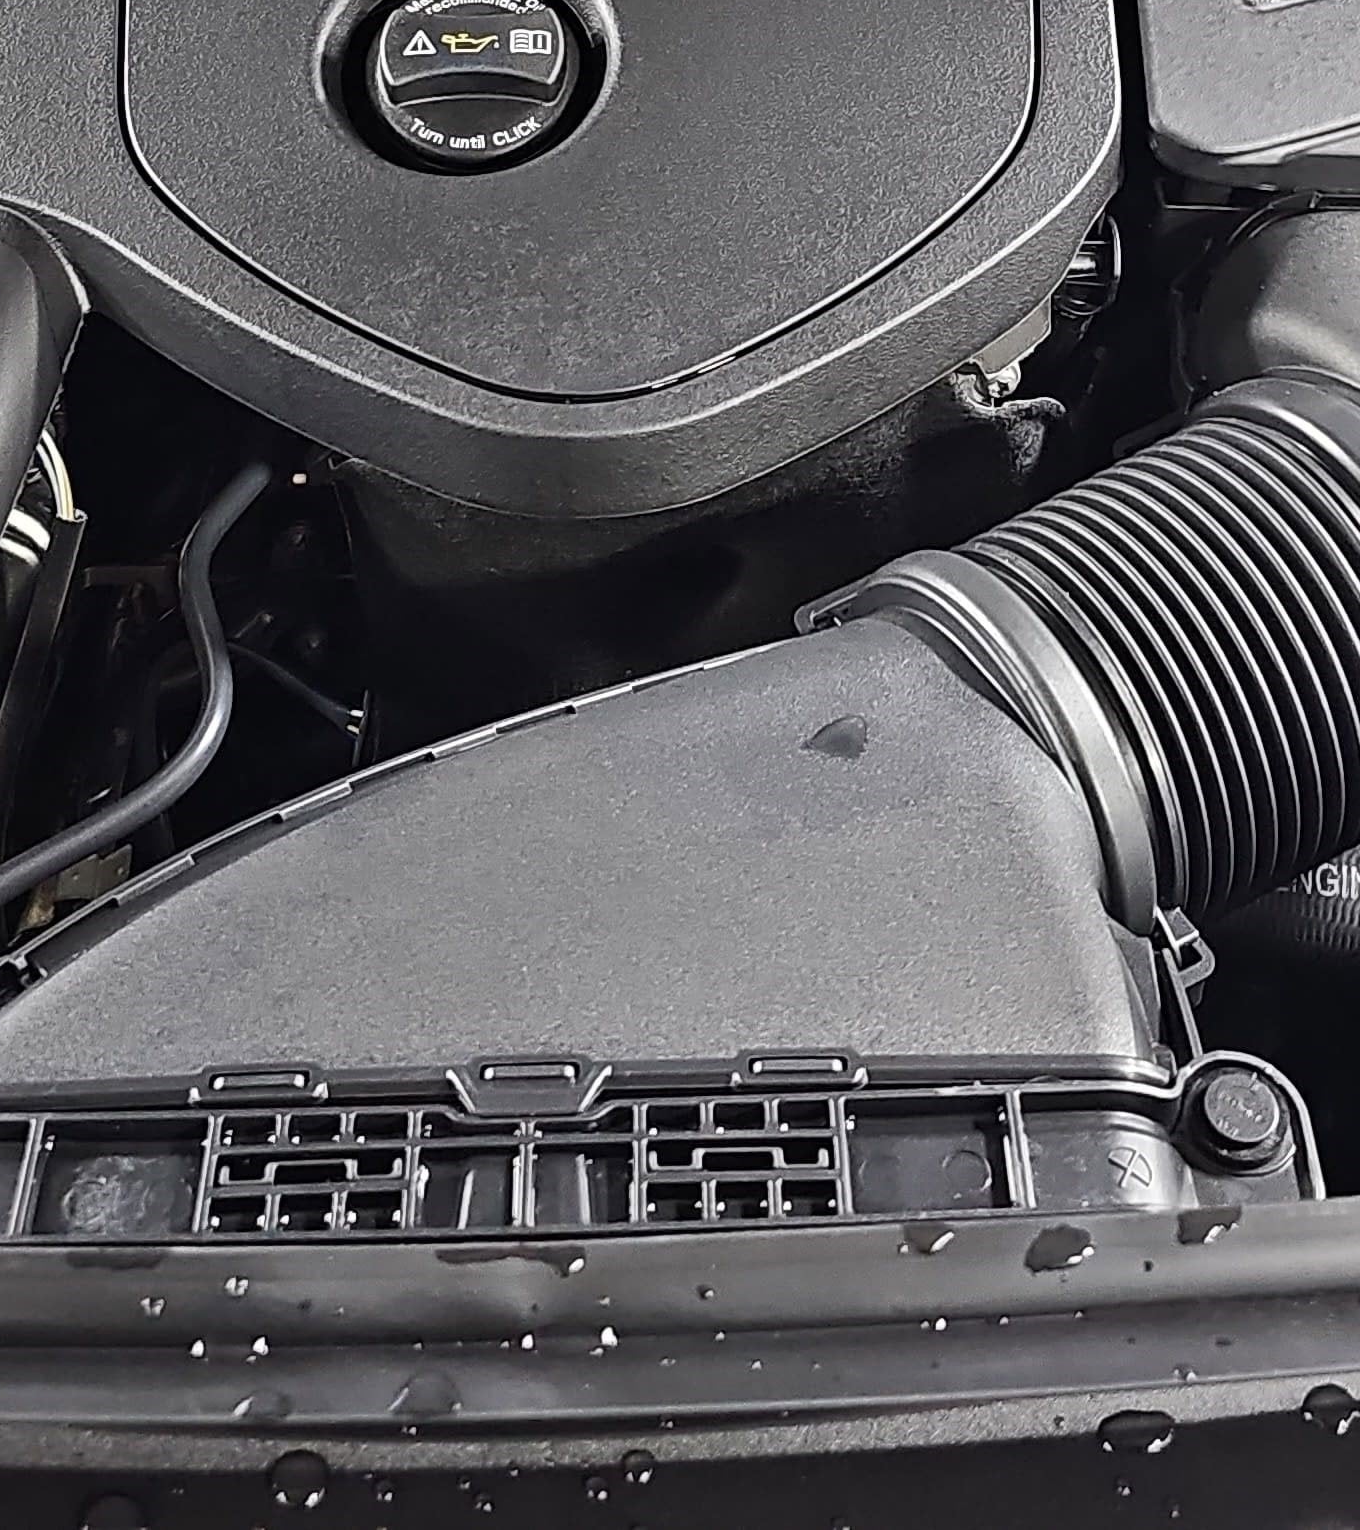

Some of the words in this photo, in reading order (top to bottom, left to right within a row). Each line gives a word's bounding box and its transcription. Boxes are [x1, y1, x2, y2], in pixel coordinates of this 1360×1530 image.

[410, 117, 444, 145] Turn
[449, 134, 486, 149] until
[492, 115, 542, 146] CLICK
